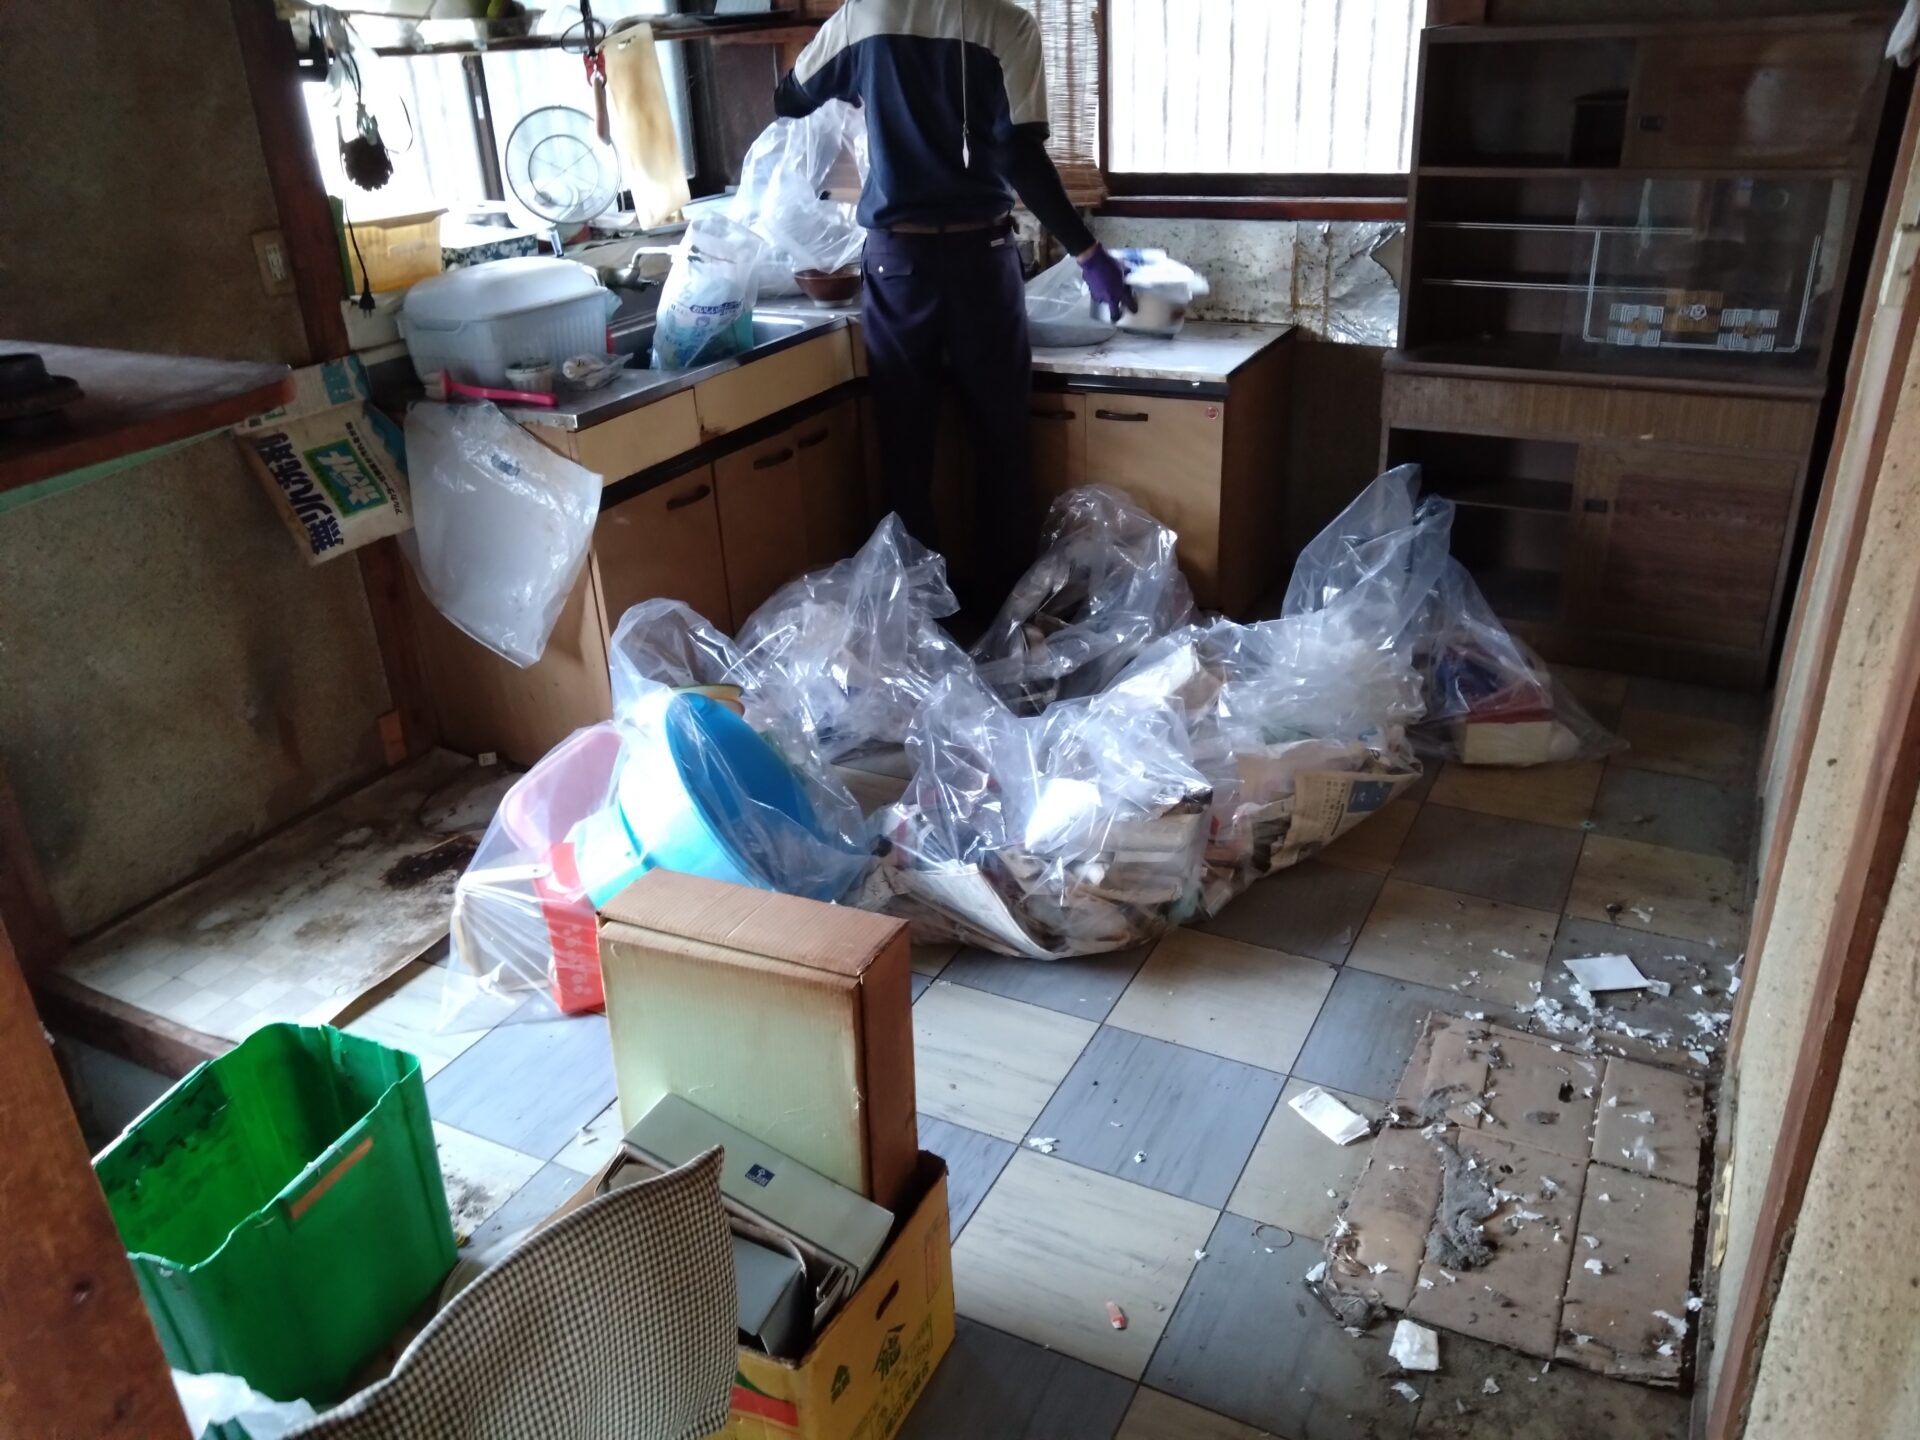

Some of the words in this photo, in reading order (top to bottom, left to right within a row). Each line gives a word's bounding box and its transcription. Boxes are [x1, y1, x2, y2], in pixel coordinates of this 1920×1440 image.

[256, 432, 344, 556] 無りん洗剤
